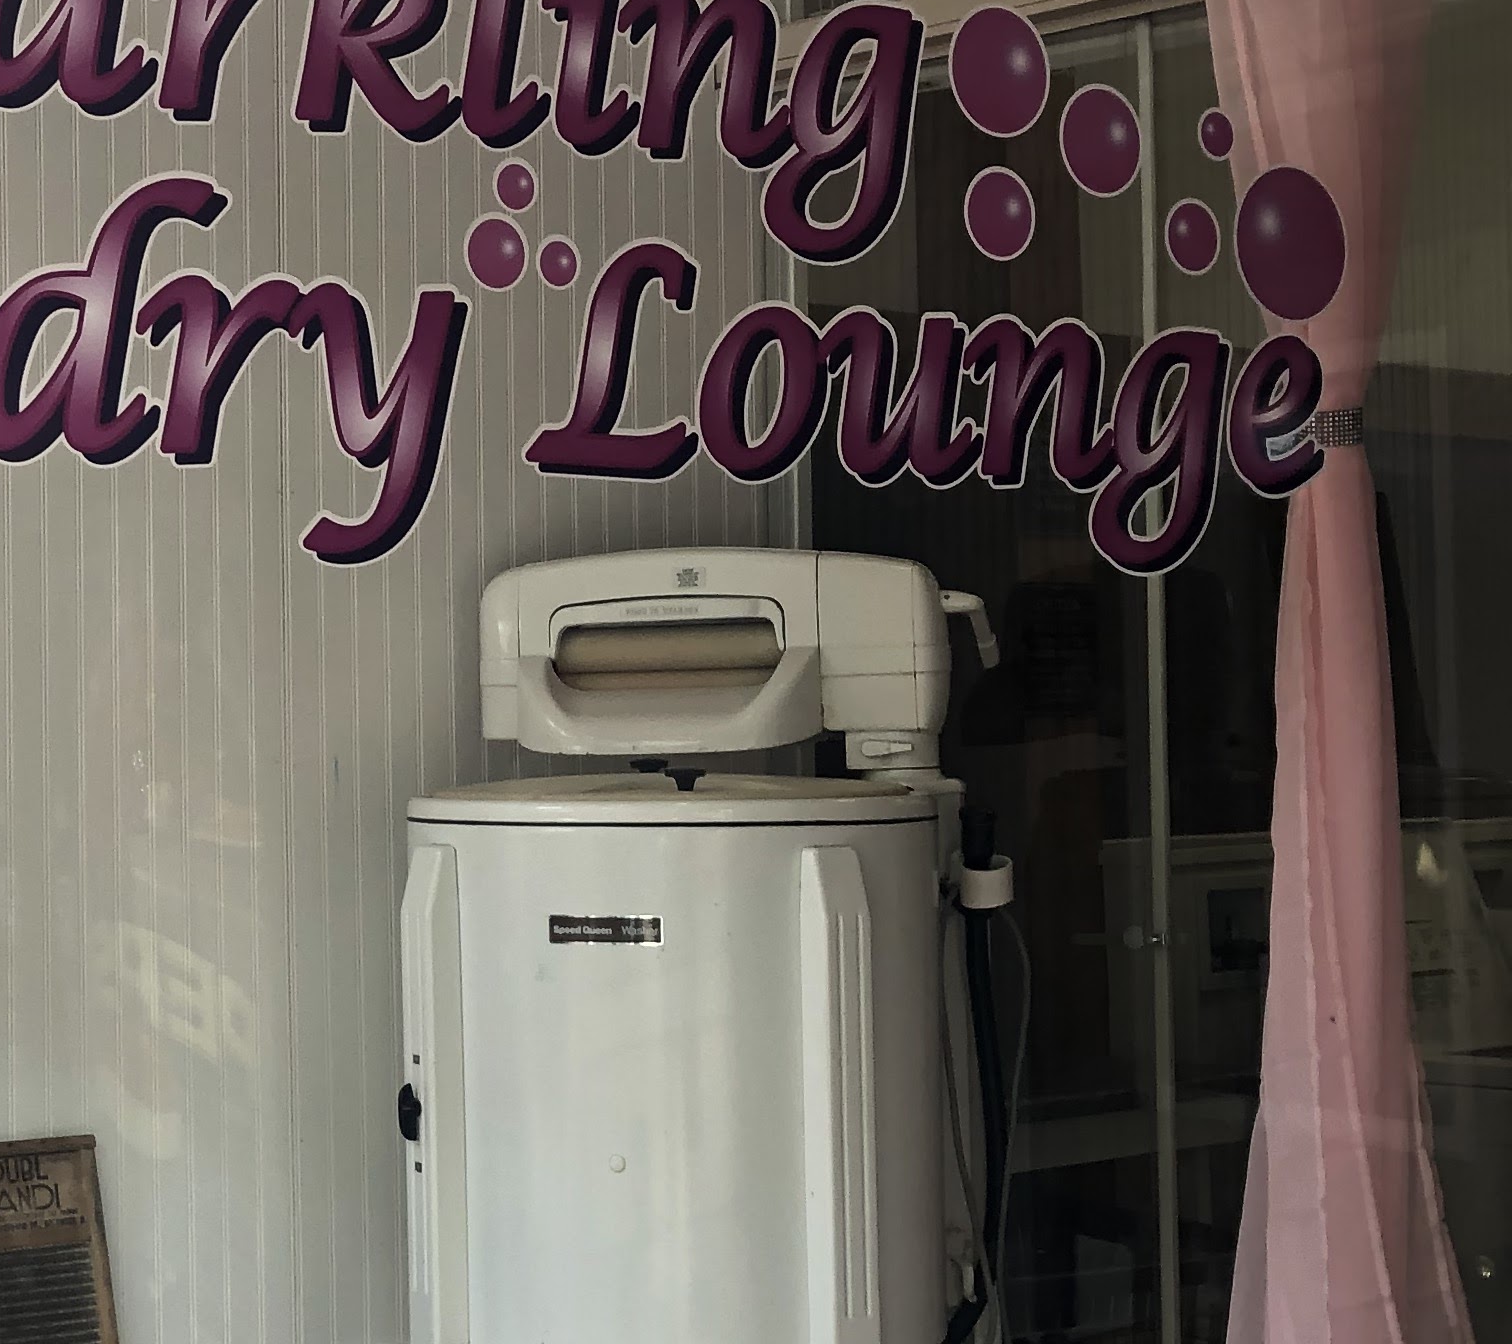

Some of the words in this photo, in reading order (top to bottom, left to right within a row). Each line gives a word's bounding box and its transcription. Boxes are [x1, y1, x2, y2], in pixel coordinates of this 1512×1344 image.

[524, 243, 1325, 573] Lounge
[553, 924, 581, 935] Speed
[582, 925, 613, 935] Queen
